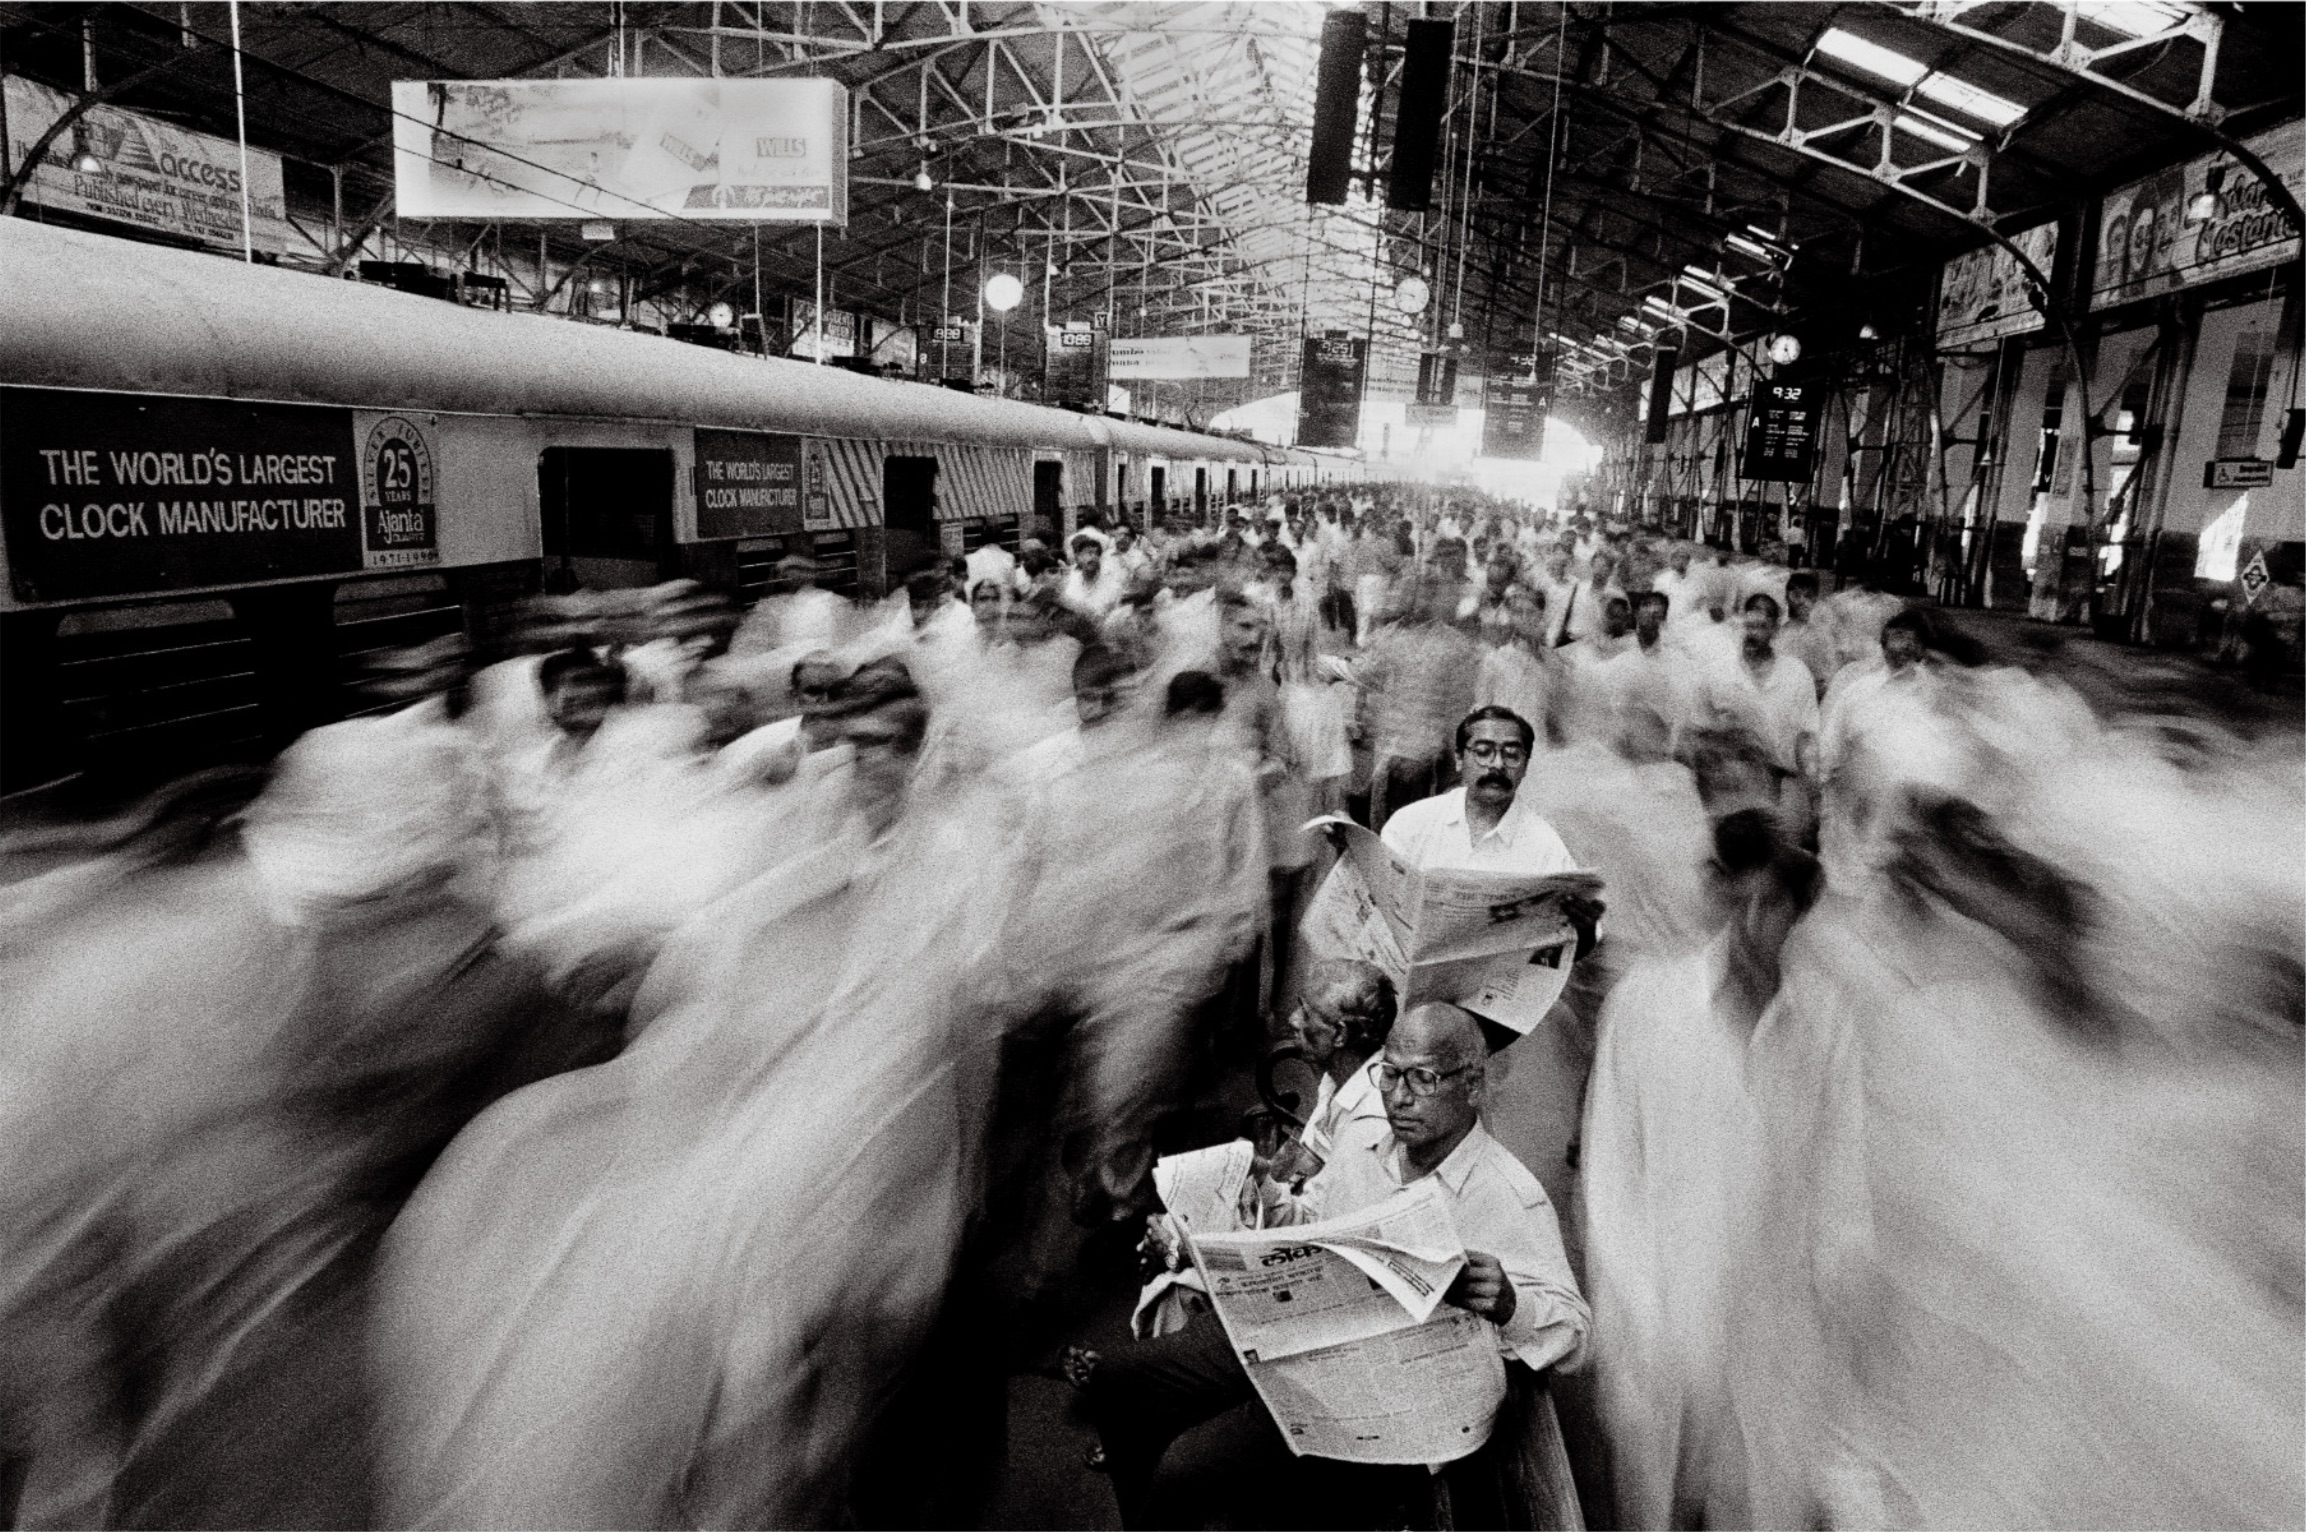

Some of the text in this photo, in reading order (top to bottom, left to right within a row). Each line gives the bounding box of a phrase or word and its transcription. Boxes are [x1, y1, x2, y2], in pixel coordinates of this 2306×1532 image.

[661, 132, 695, 165] WILLS
[757, 138, 805, 157] WILLS
[161, 152, 242, 192] access
[74, 174, 140, 210] Published
[39, 447, 337, 486] THE WORLD'S LARGEST
[383, 448, 412, 488] 25
[705, 459, 795, 480] THE WORLD'S LARGEST
[384, 489, 413, 503] YEARS
[705, 488, 798, 509] CLOCK MANUFACTURER
[39, 498, 347, 541] CLOCK MANUFACTURER
[376, 508, 425, 545] Ajanta
